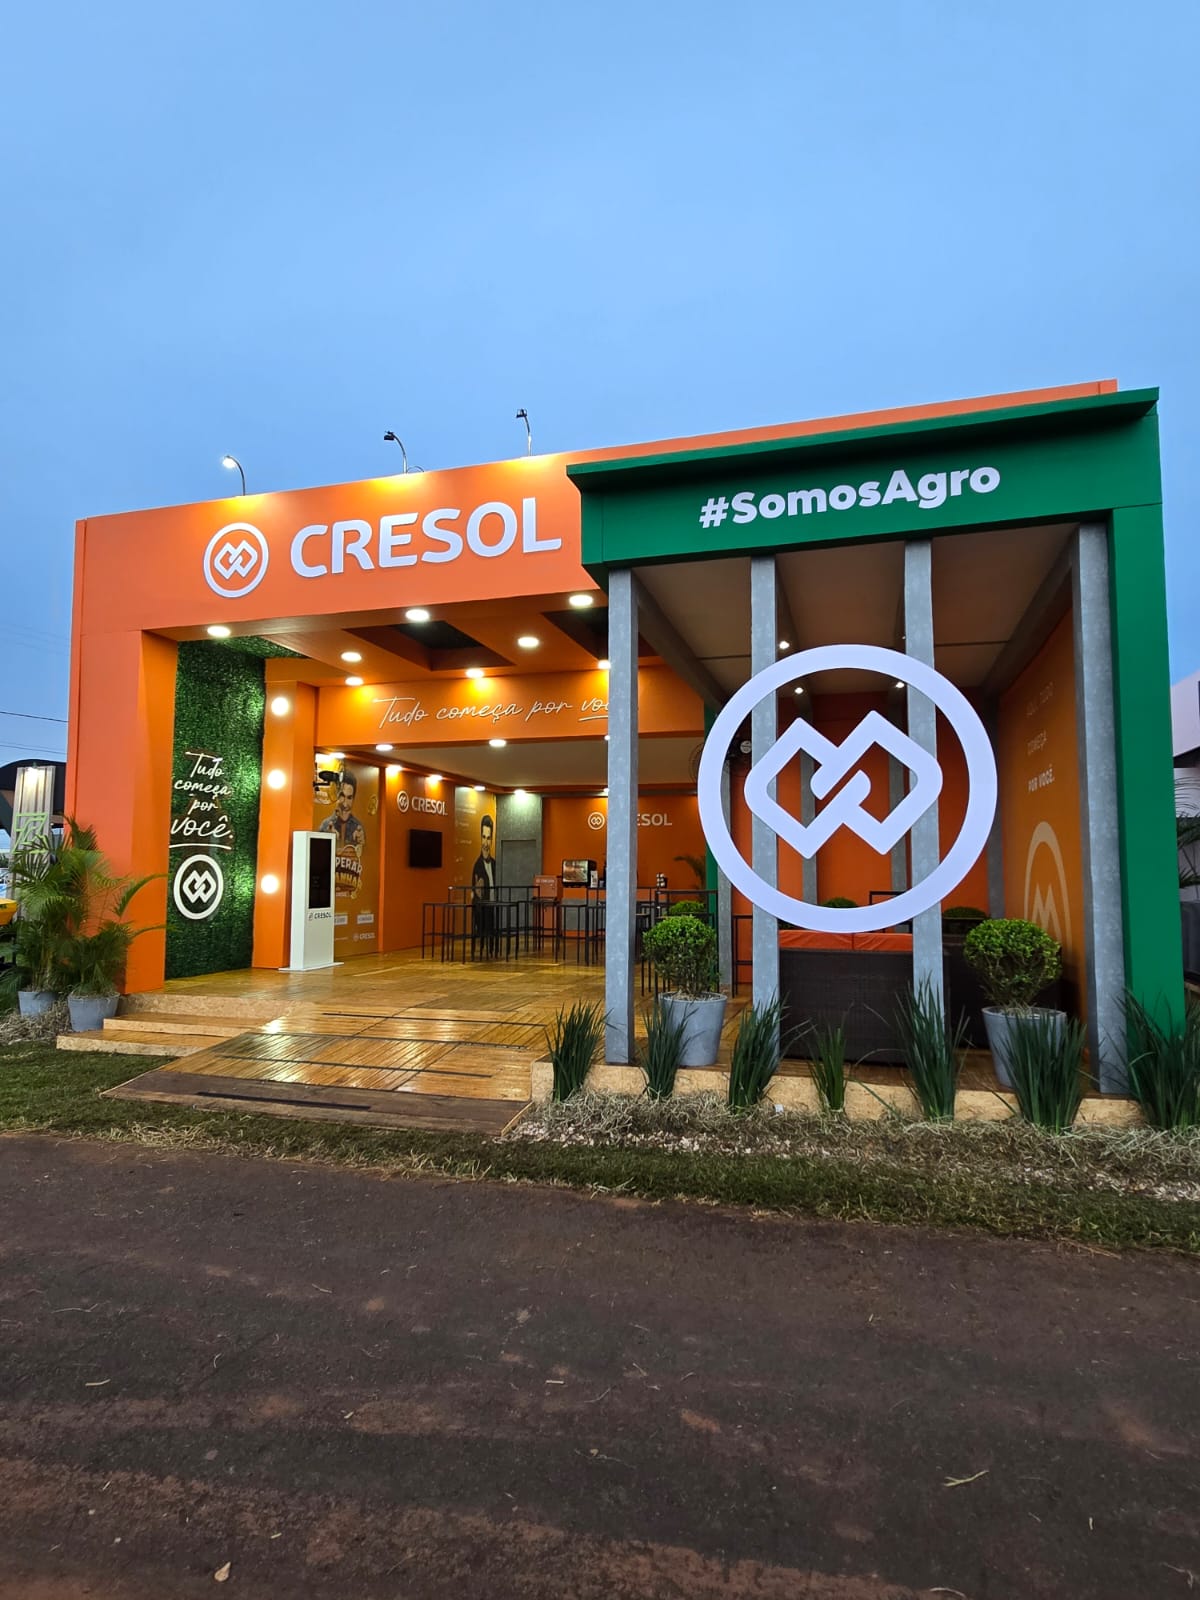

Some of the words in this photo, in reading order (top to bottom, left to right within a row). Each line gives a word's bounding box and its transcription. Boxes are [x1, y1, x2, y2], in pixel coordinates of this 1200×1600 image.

[699, 466, 1001, 529] #SomosAgro
[290, 497, 562, 578] CRESOL
[372, 696, 429, 729] Tudo
[435, 702, 524, 724] começa
[525, 700, 573, 721] por
[185, 751, 225, 779] Tudo
[174, 778, 232, 799] começa
[187, 799, 219, 815] por
[411, 796, 448, 816] CRESOL
[637, 813, 672, 826] SOL
